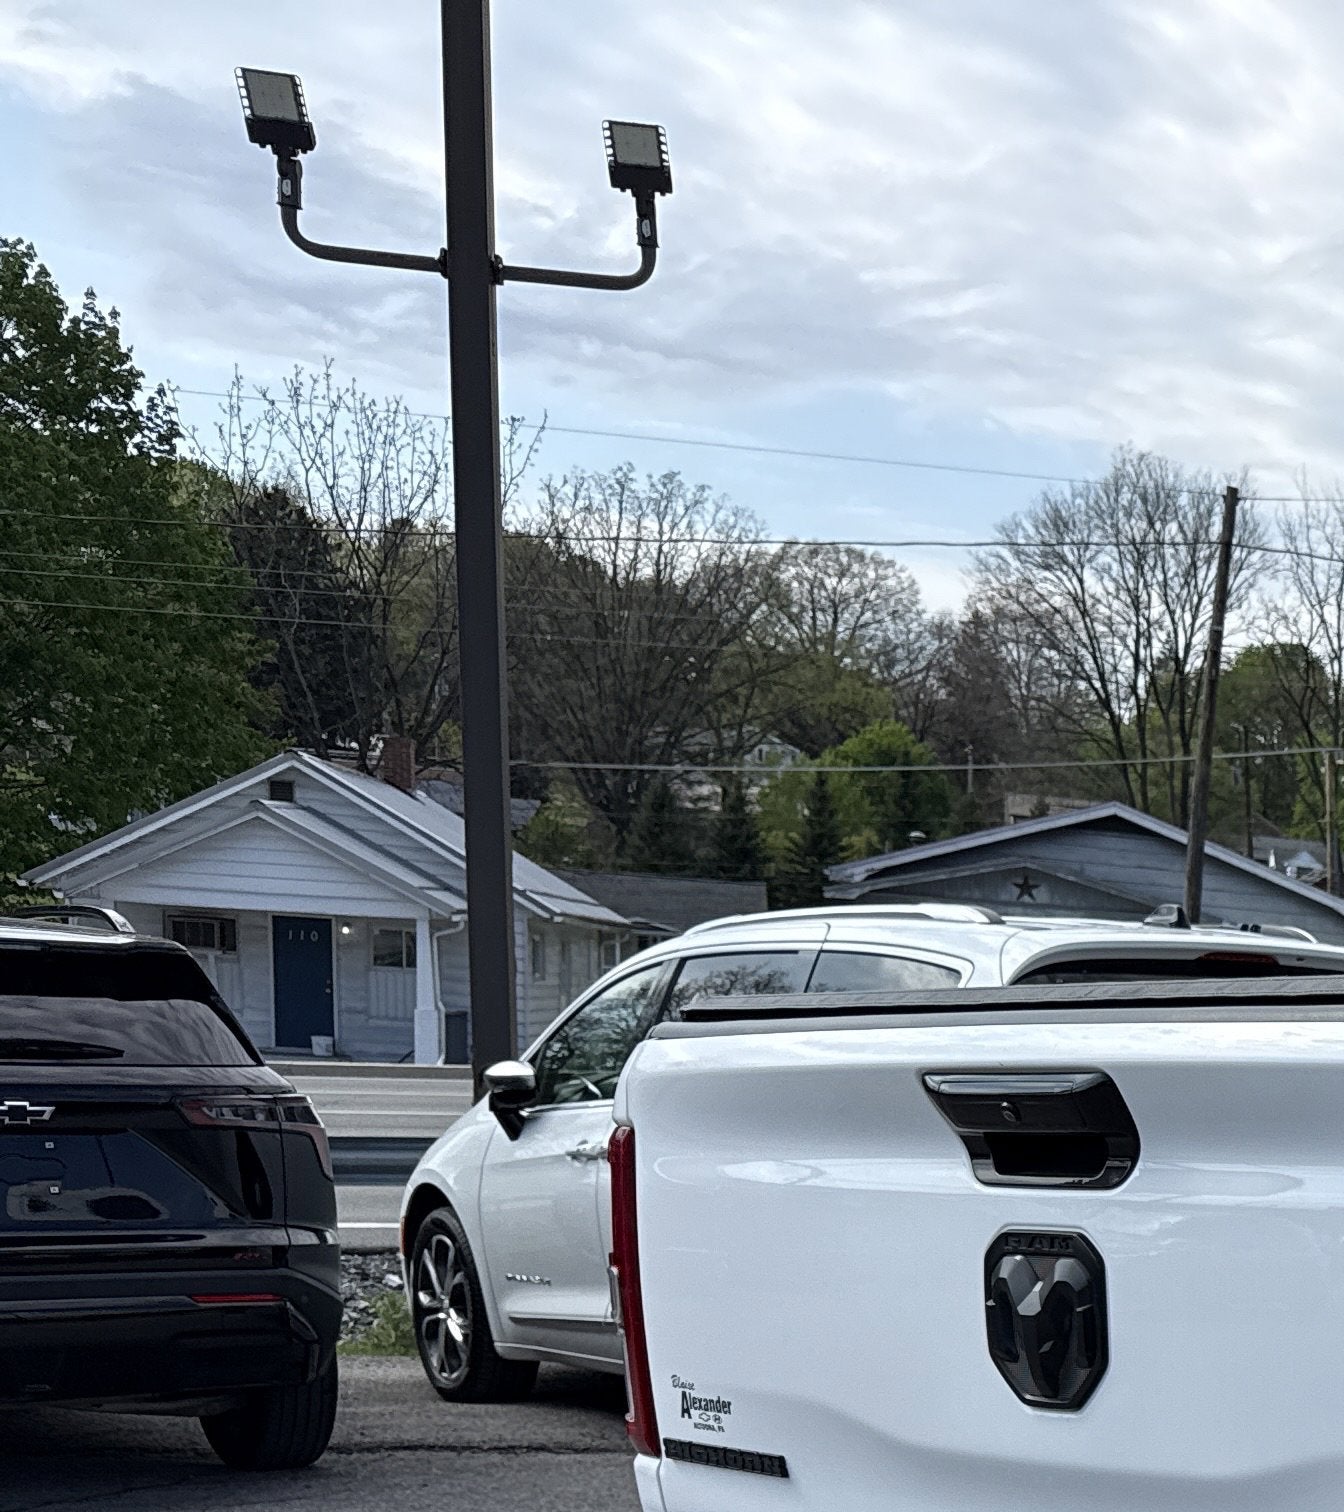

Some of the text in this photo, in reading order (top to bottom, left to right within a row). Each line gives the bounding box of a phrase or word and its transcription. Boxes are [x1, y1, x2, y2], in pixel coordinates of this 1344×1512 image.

[288, 929, 319, 942] 110
[1004, 1235, 1073, 1251] RAM
[680, 1391, 732, 1420] Alexander
